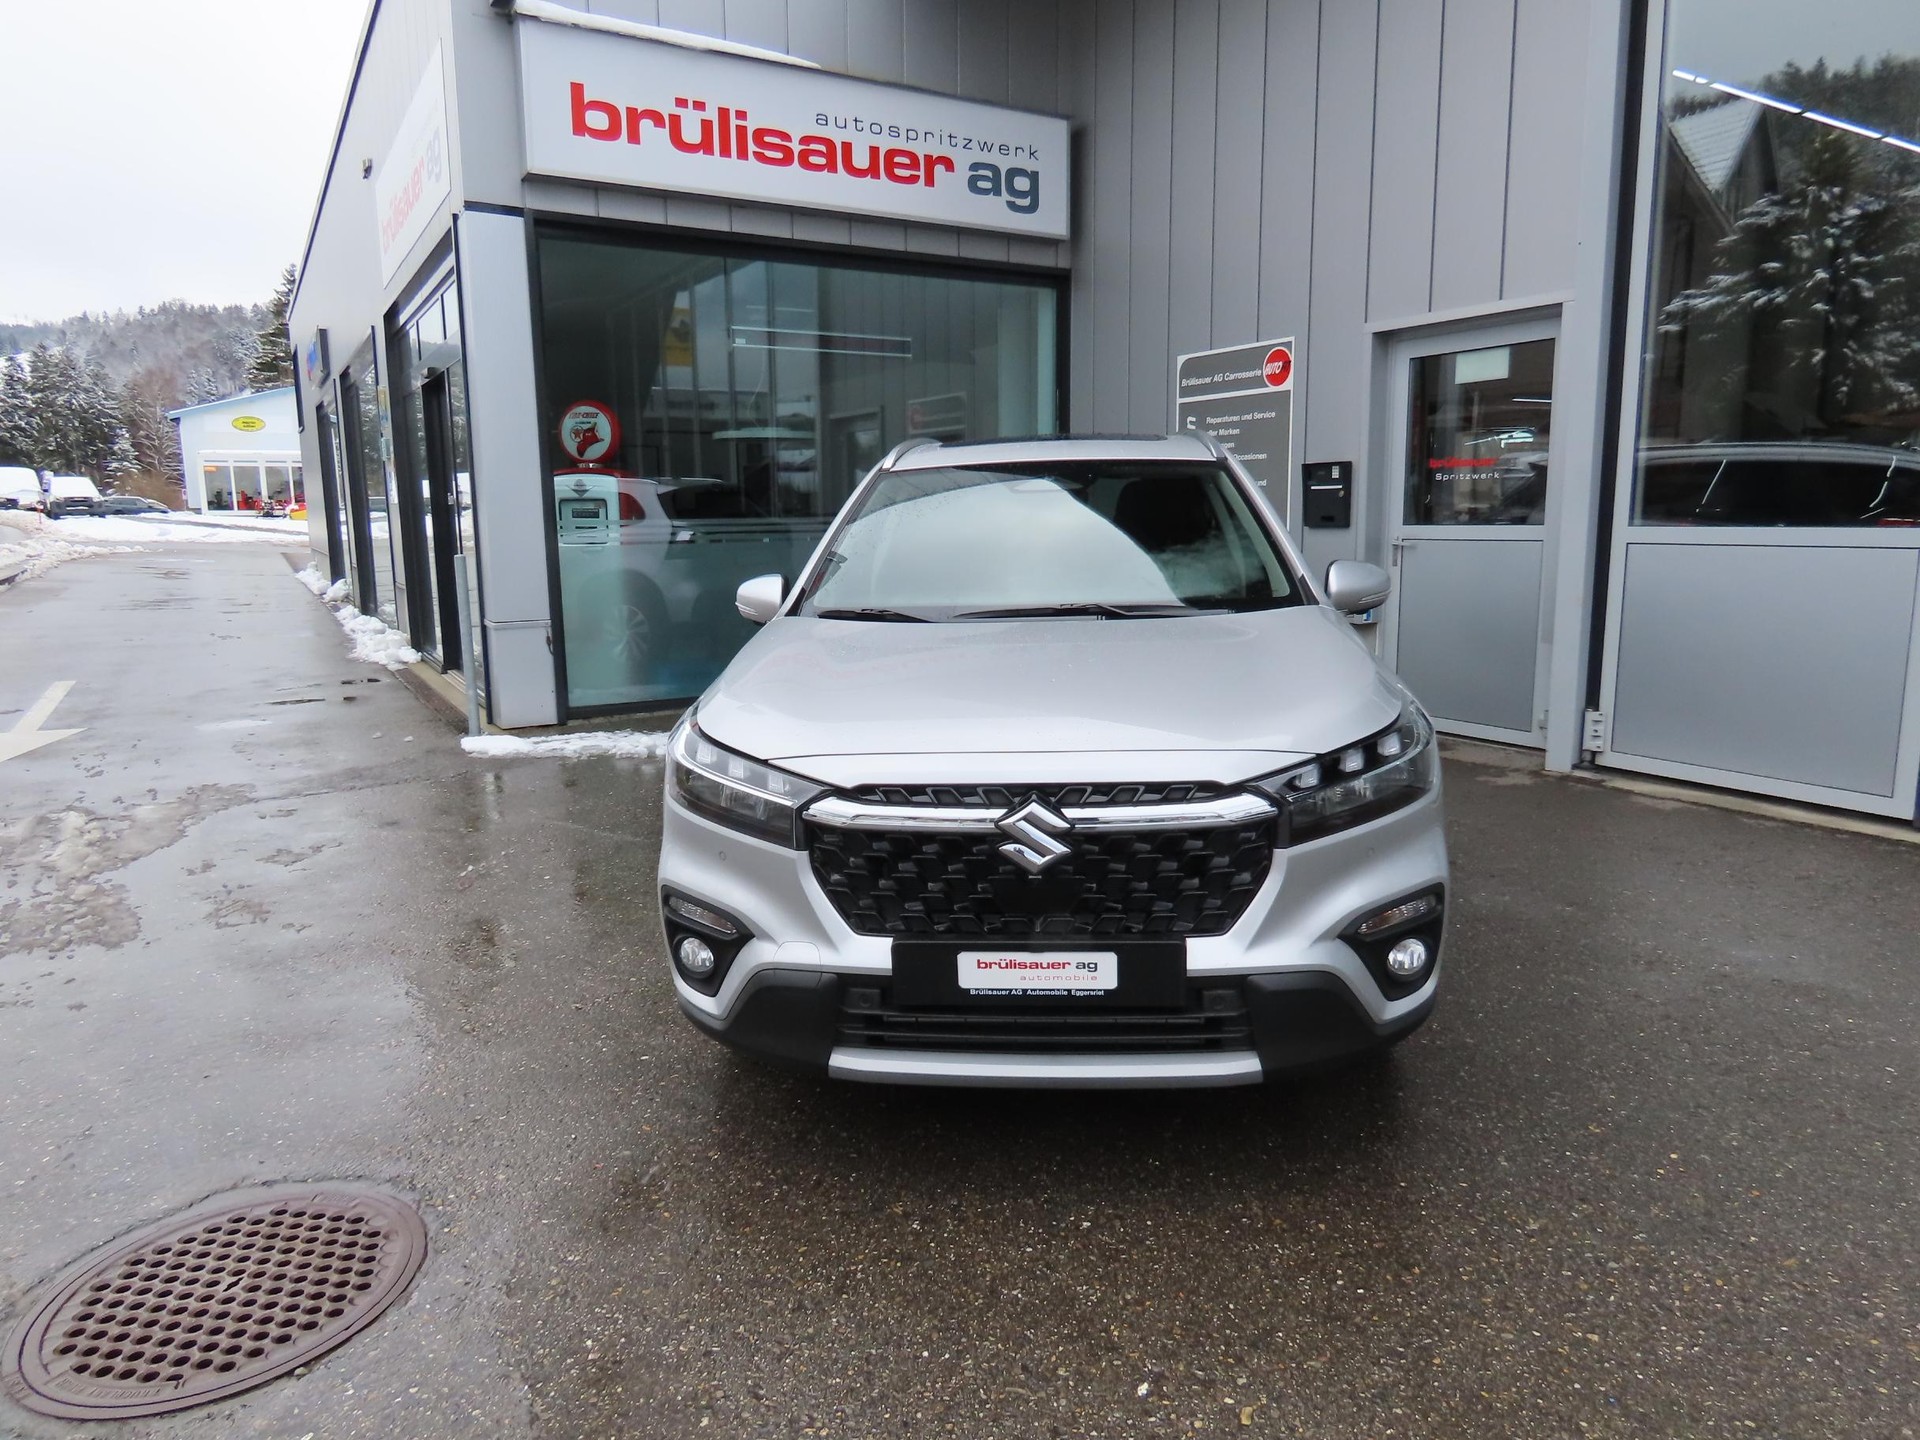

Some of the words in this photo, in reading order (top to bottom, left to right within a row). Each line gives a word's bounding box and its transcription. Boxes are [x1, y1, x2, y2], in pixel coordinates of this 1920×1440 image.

[815, 113, 1039, 161] autospritzwerk
[570, 82, 955, 187] brülisauer
[967, 162, 1039, 214] ag
[1181, 375, 1212, 387] Brülisauer
[1212, 373, 1223, 382] AG
[1224, 368, 1262, 381] Carrosserie
[1206, 414, 1240, 424] Reparaturen
[1241, 412, 1253, 421] und
[1253, 411, 1276, 420] Service
[1219, 428, 1240, 436] Marken
[1435, 471, 1500, 481] Spritzwerk
[977, 958, 1071, 970] brülisauer
[1075, 961, 1098, 972] ag
[970, 988, 1010, 996] Brülisauer
[1071, 989, 1105, 997] Eggersriet
